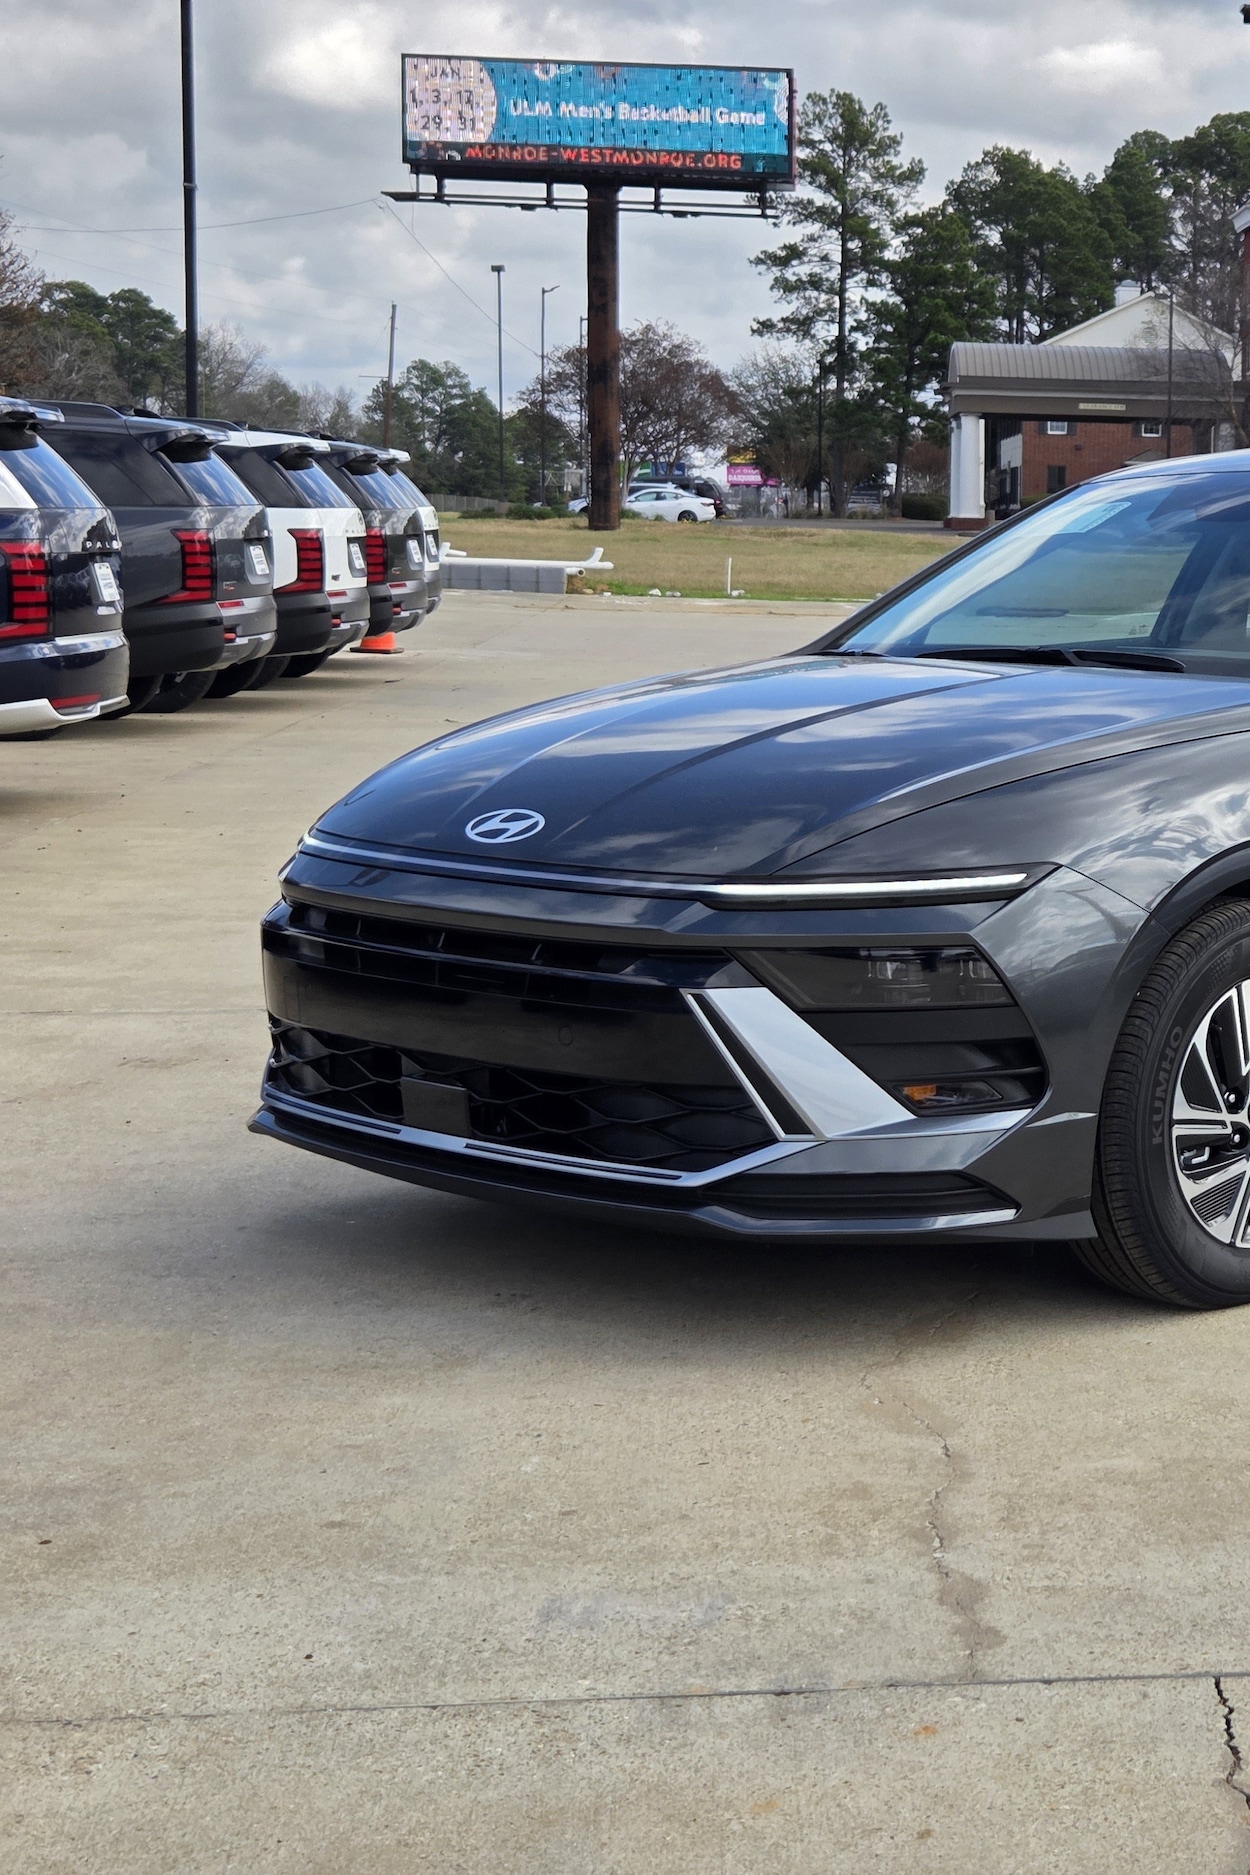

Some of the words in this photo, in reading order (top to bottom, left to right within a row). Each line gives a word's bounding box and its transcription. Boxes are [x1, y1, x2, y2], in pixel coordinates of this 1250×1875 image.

[431, 66, 461, 79] JAN
[509, 98, 553, 117] ULM
[559, 100, 613, 120] Men's
[618, 101, 711, 124] Basketball
[715, 106, 766, 126] Game
[465, 145, 742, 170] MONROE-WESTMONROE.ORG
[1152, 1026, 1183, 1145] KUMHO
